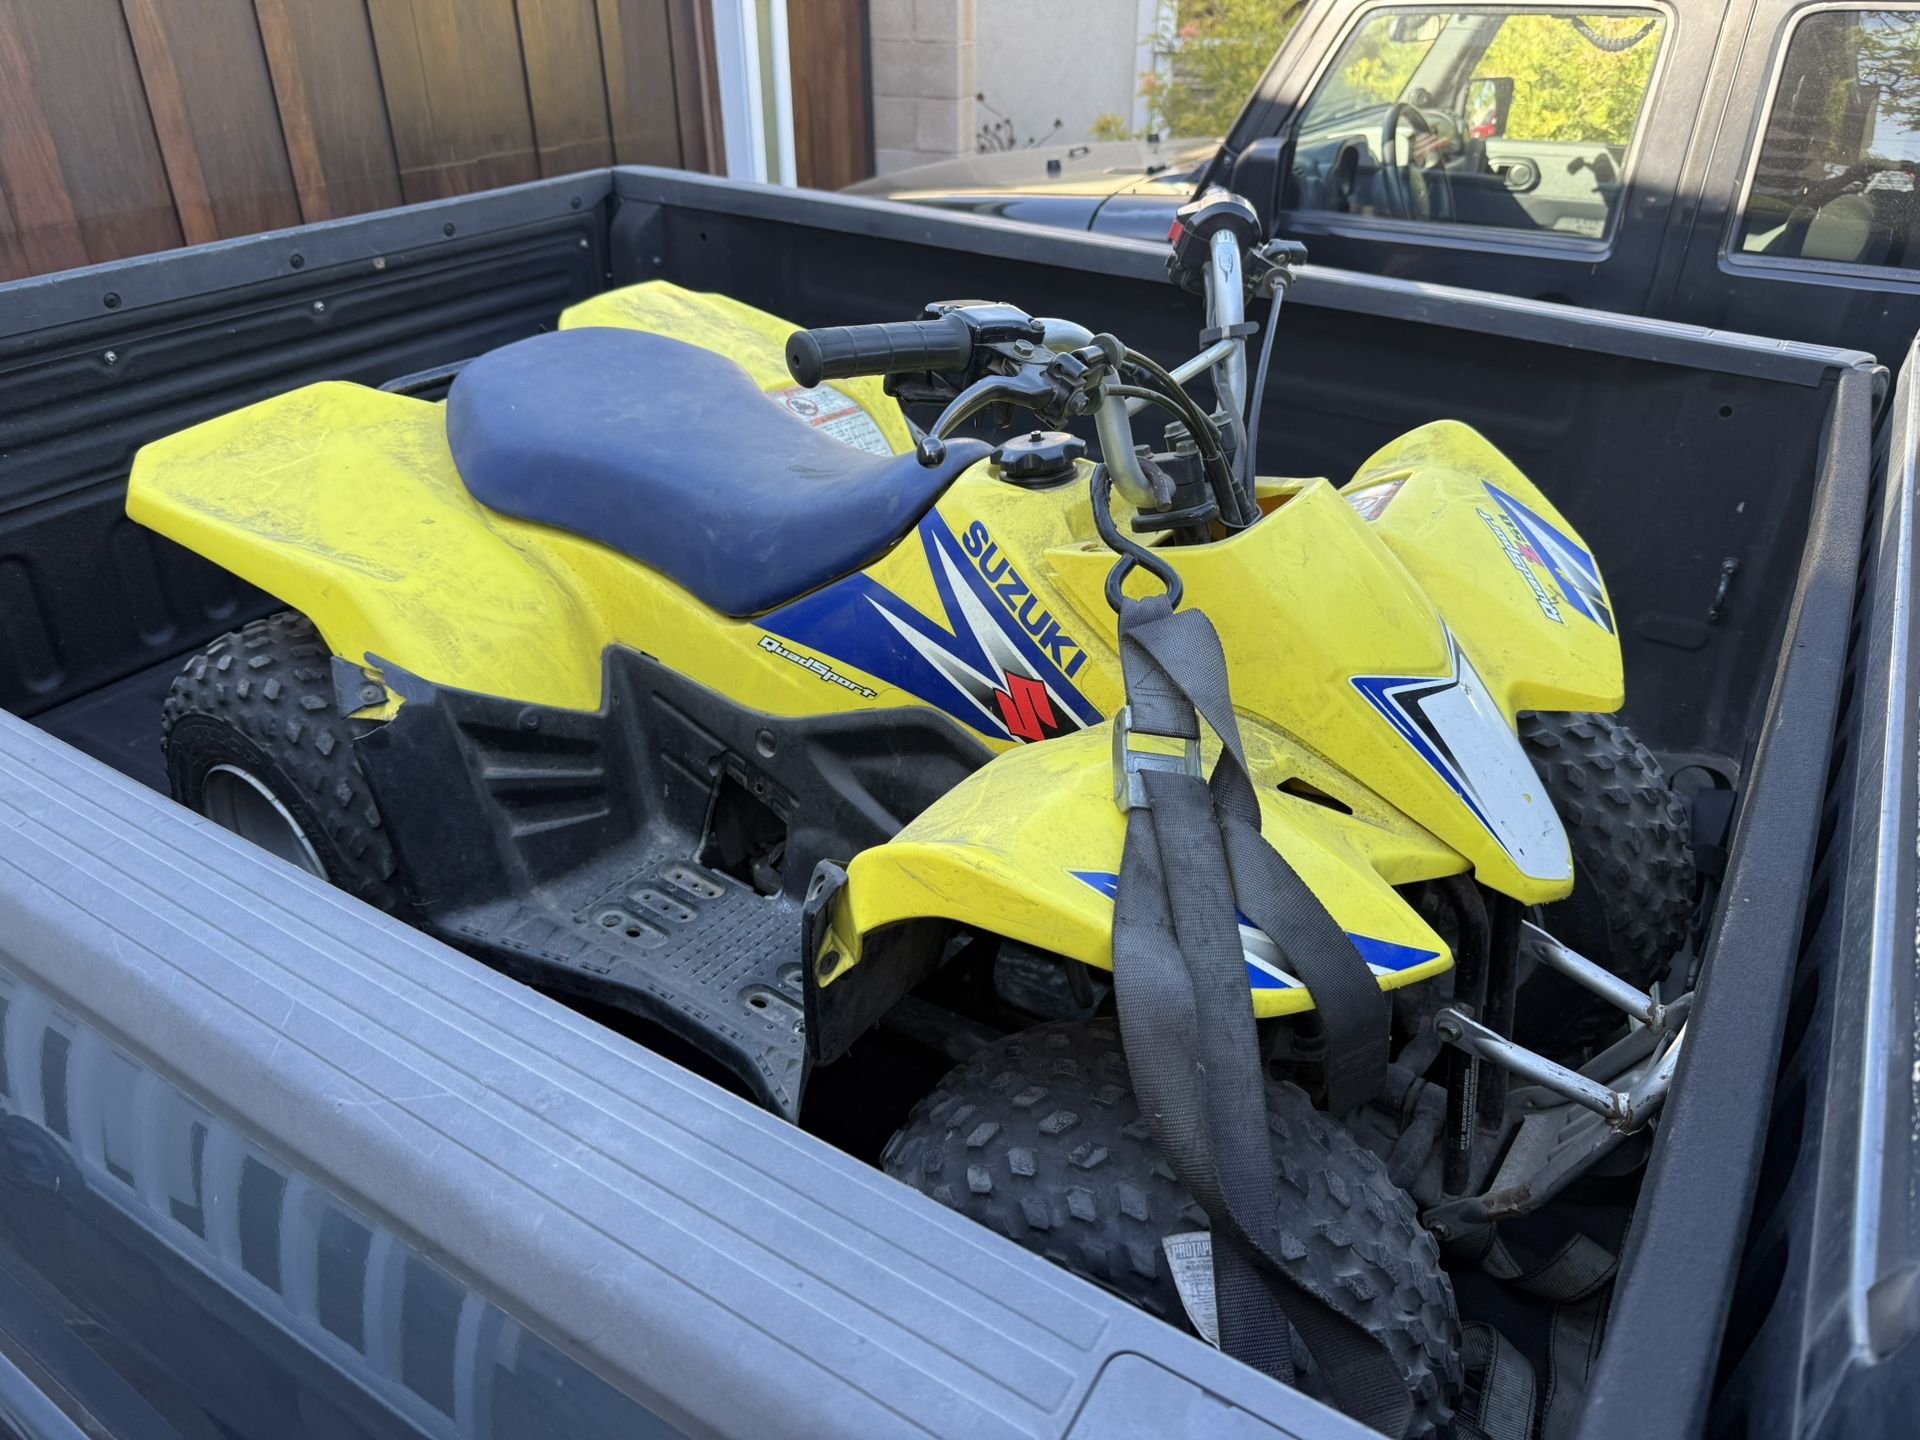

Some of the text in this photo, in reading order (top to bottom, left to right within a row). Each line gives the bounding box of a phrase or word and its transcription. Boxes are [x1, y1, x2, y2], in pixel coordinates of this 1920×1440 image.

[962, 520, 1088, 679] SUZUKI
[1475, 508, 1564, 624] QuadSport
[757, 635, 878, 699] QuadSport
[1171, 1240, 1212, 1260] PROTAP
